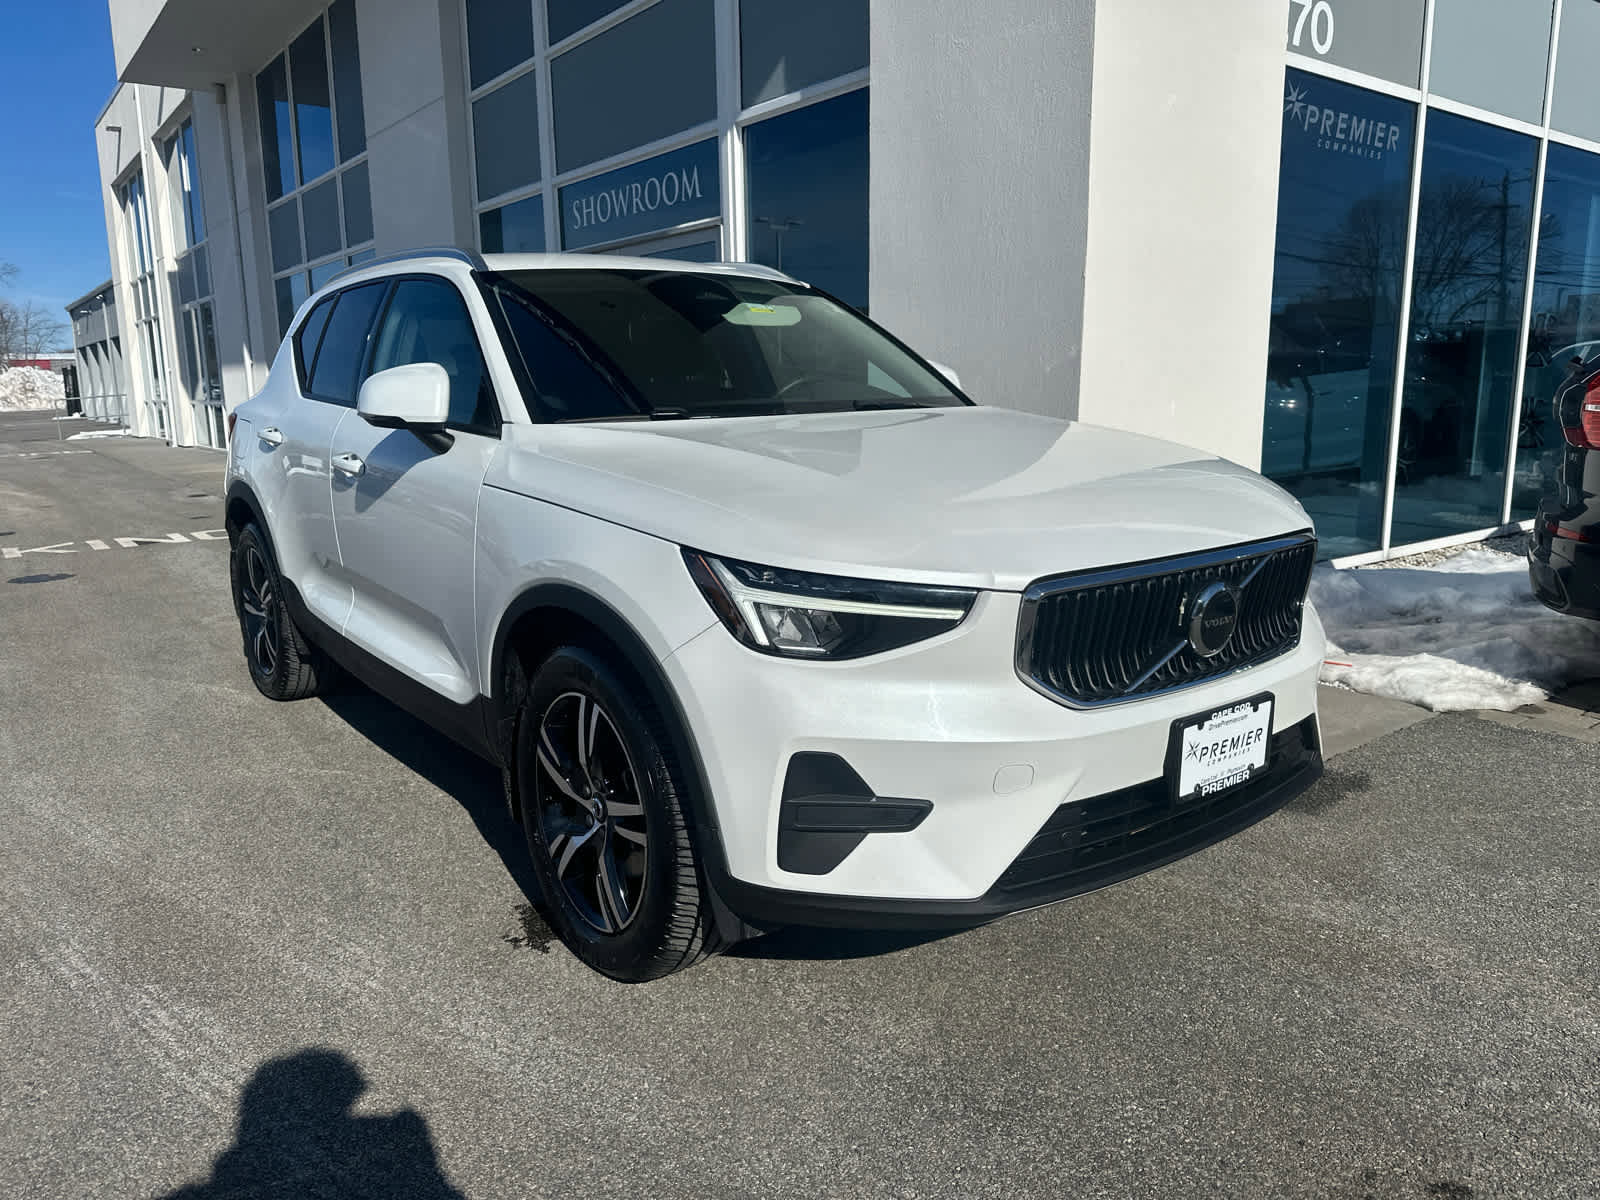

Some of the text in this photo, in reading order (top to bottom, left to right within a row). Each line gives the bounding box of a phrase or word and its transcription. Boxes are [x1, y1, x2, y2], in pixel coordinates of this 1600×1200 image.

[1304, 104, 1400, 151] PREMIER
[1317, 138, 1382, 160] COMPANIES
[572, 164, 703, 230] SHOWROOM
[1199, 727, 1263, 763] PREMIER
[1201, 769, 1250, 797] PREMIER
